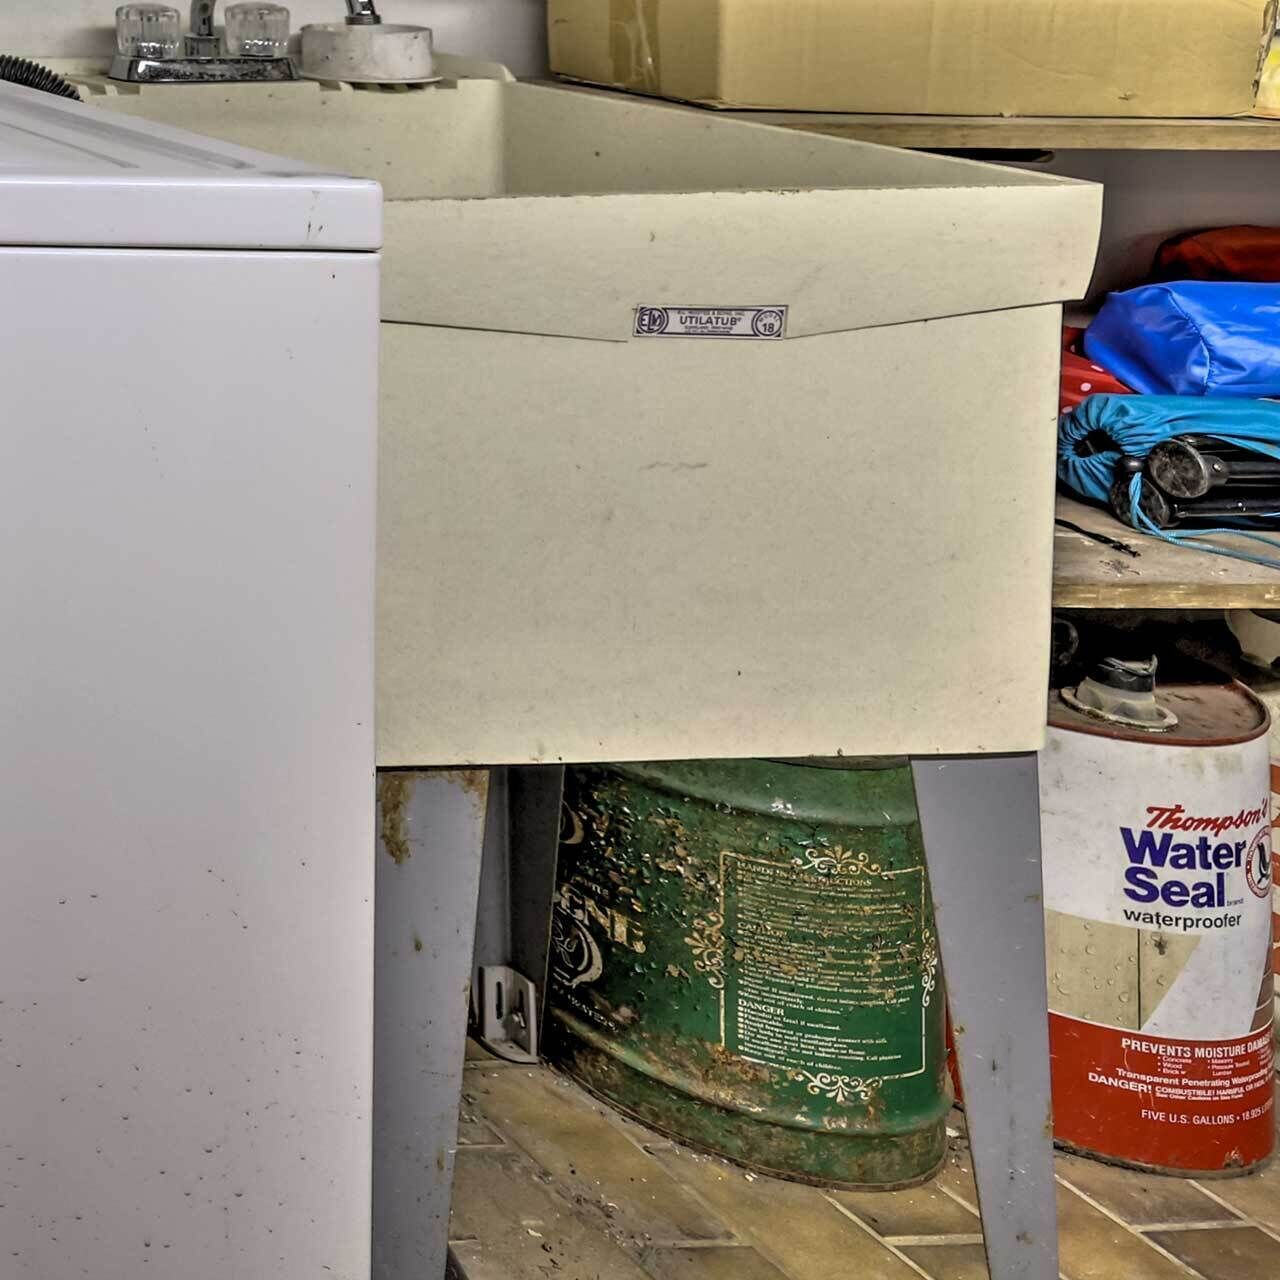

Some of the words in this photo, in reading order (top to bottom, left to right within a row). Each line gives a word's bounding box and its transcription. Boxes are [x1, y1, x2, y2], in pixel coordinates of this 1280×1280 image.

[763, 323, 774, 333] 18
[1146, 797, 1268, 837] Thompson's
[1120, 827, 1246, 870] Water
[1123, 866, 1225, 908] Seal
[1227, 898, 1244, 907] brand
[1123, 909, 1242, 932] waterproofer
[739, 998, 784, 1015] DANGER
[1122, 1038, 1191, 1058] PREVENTS
[1195, 1043, 1246, 1059] MOISTURE
[1088, 1072, 1152, 1094] DANGER!
[1155, 1086, 1215, 1096] COMBUSTIBLE!
[1116, 1068, 1180, 1086] Transparent
[1182, 1077, 1230, 1087] Penetrating
[1141, 1109, 1166, 1122] FIVE
[1169, 1113, 1190, 1125] U.S.
[1192, 1114, 1235, 1126] GALLONS
